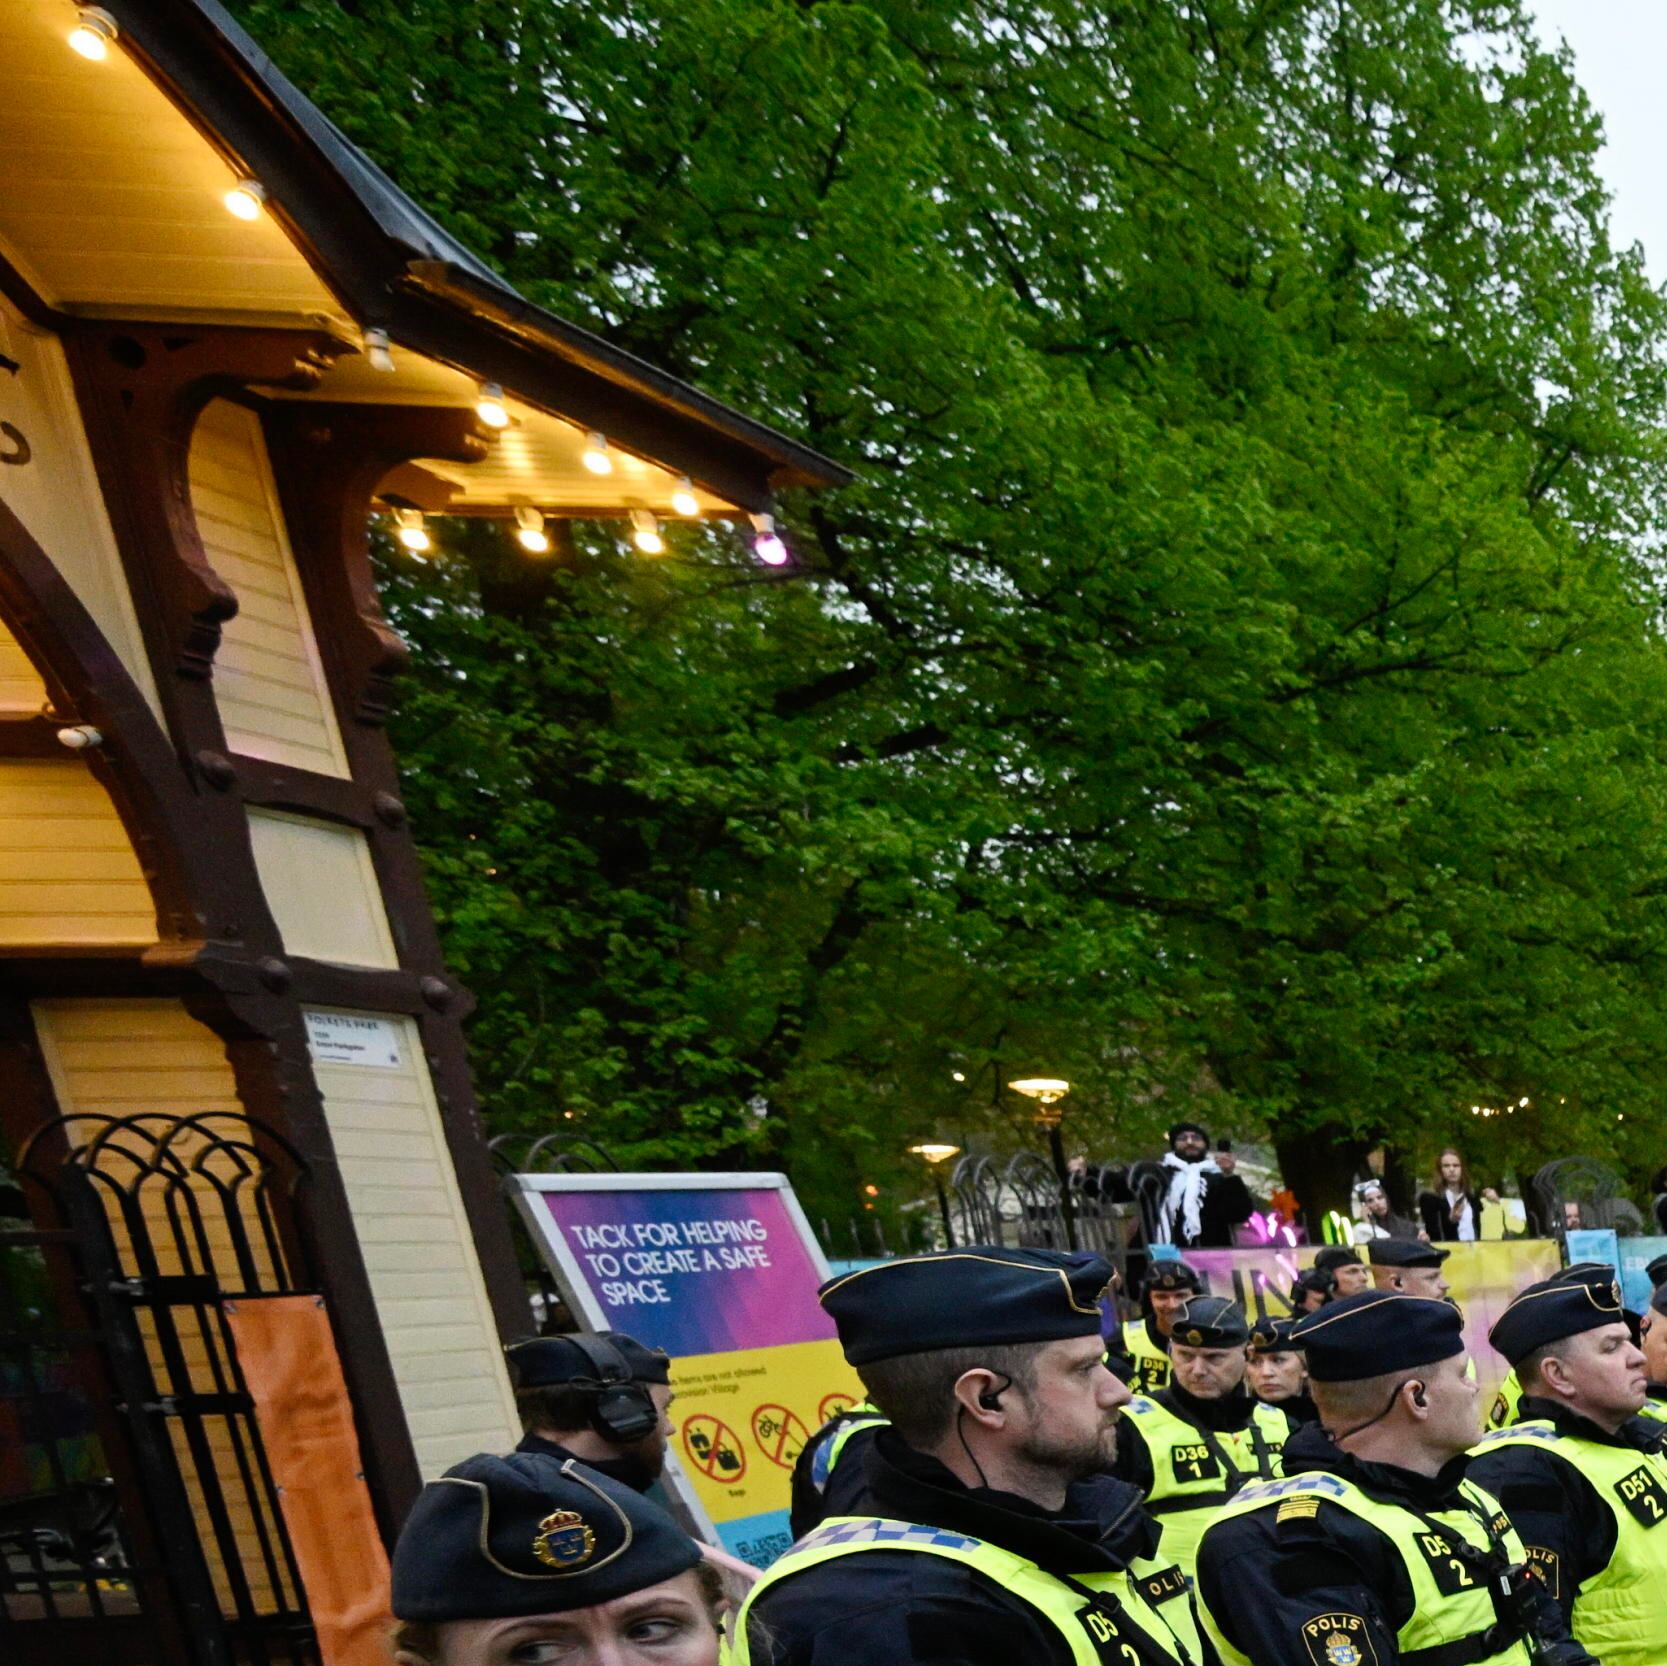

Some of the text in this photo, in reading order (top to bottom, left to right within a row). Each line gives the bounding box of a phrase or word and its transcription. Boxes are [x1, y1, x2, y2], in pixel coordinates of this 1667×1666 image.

[570, 1219, 767, 1249] TACK FOR HELPING
[585, 1245, 772, 1277] TO CREATE A SAFE
[601, 1279, 671, 1306] SPACE
[1175, 1445, 1209, 1462] D36
[1189, 1462, 1202, 1478] 1
[1621, 1470, 1652, 1500] D51
[1644, 1495, 1664, 1519] 2
[1422, 1535, 1452, 1558] D5
[1450, 1559, 1473, 1586] 2
[1086, 1611, 1119, 1643] D5
[1306, 1616, 1361, 1638] POLIS
